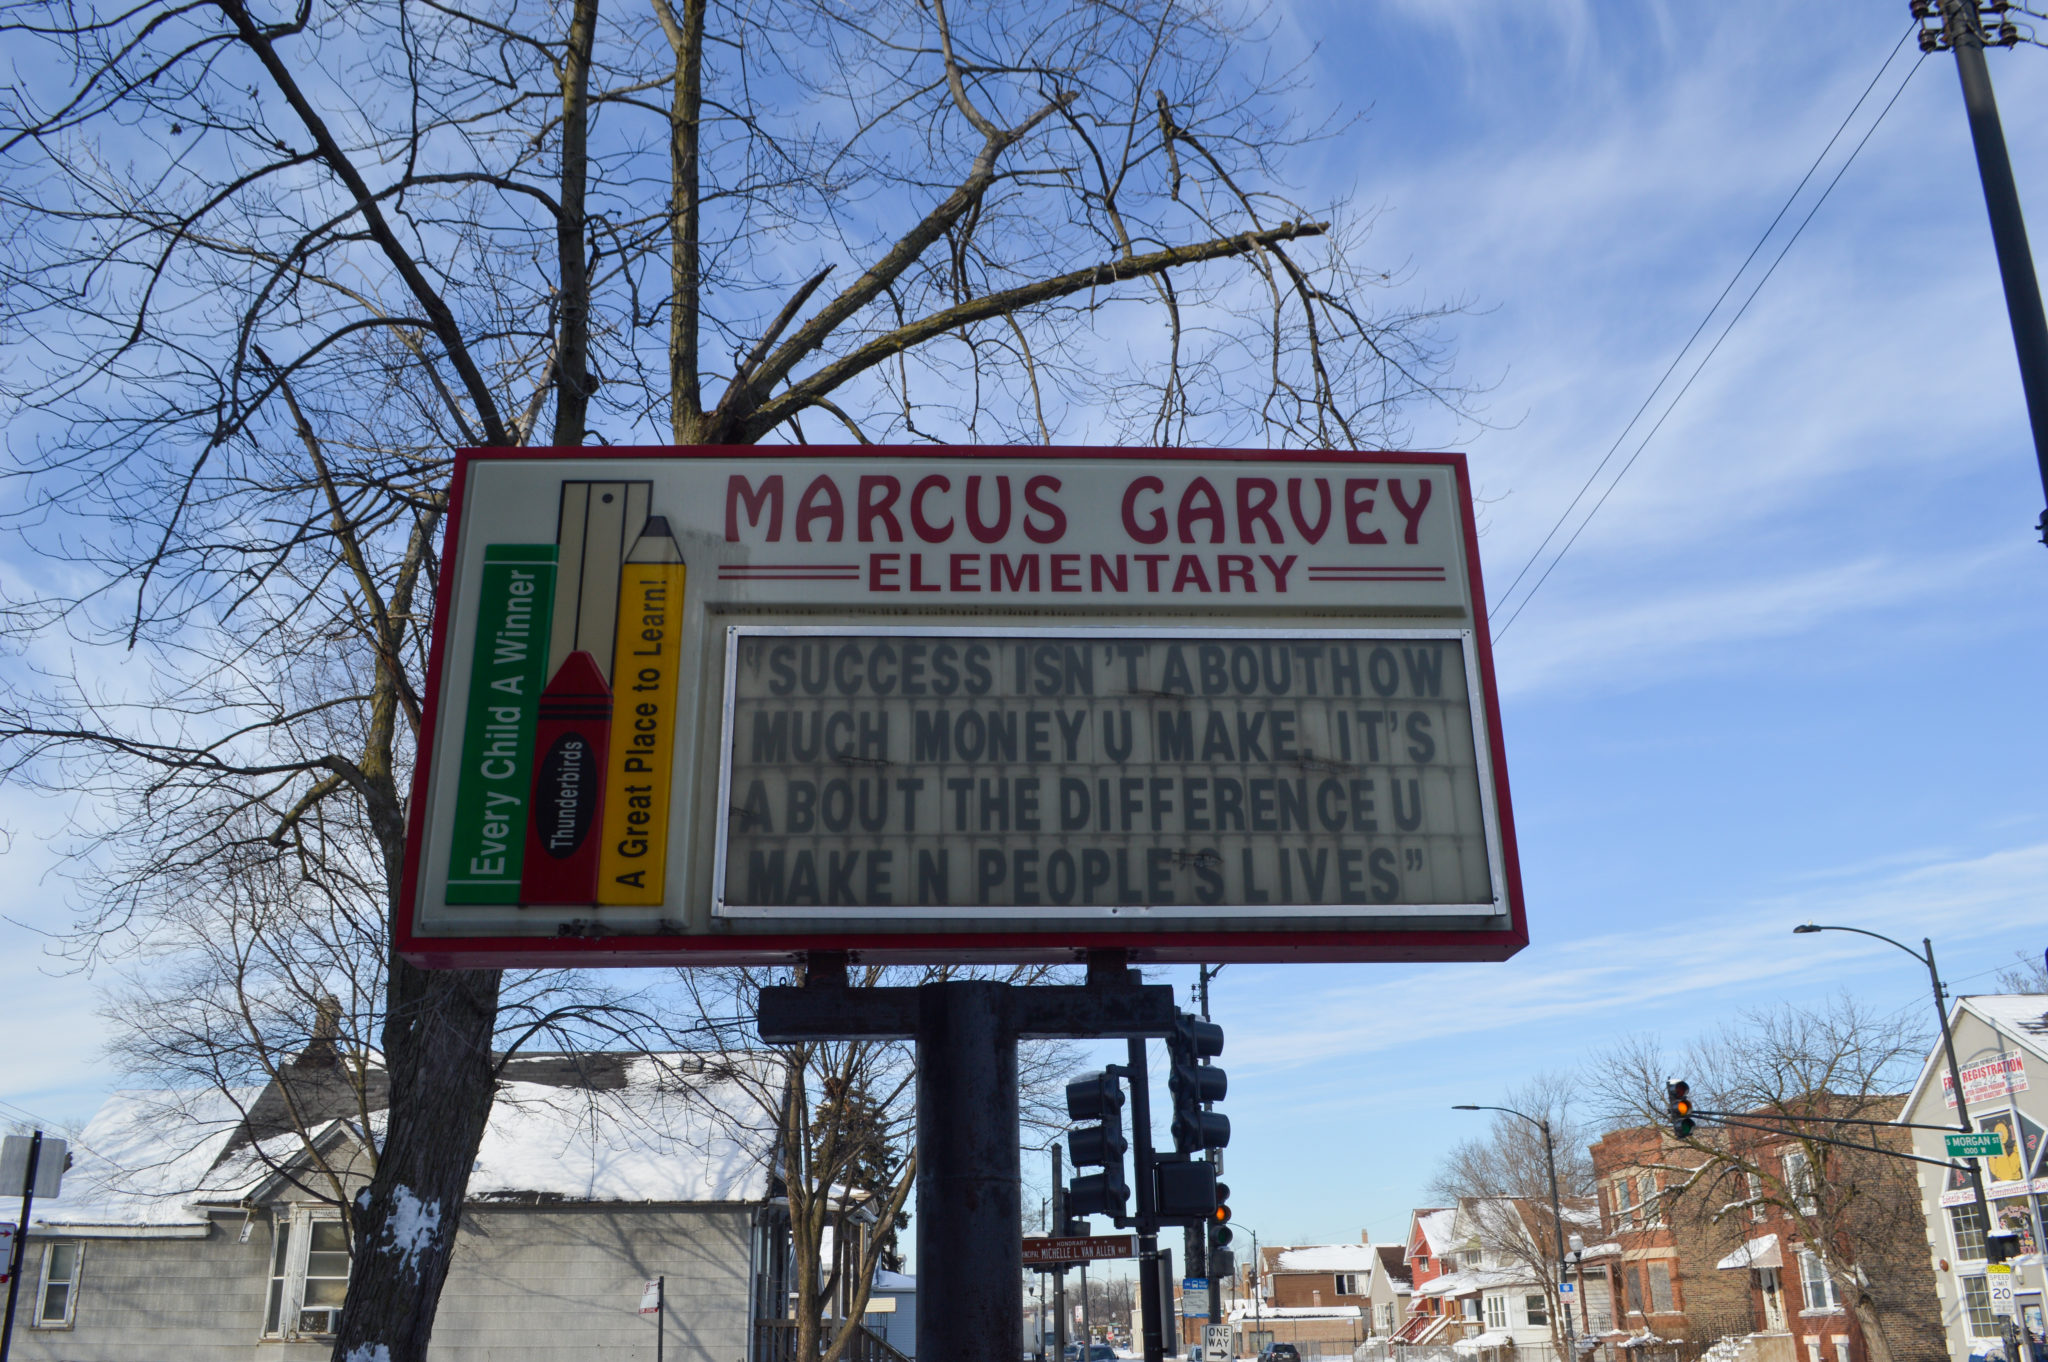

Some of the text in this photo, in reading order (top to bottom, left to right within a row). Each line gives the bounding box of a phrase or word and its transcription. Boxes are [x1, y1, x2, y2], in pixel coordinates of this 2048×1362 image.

[725, 474, 1432, 545] MARCUS GARVEY
[869, 553, 1299, 593] ELEMENTARY
[1016, 644, 1145, 696] ISN'T
[470, 569, 535, 875] Every Child A Winner
[616, 580, 667, 889] A Great Place to Learn!
[752, 710, 890, 763] MUCH
[914, 709, 1086, 762] MONEY
[1103, 710, 1133, 763] U
[1336, 710, 1436, 764] IT'S
[550, 741, 584, 849] Thunderbirds
[738, 777, 1422, 834] ABOUT THE DIFFERENCE U
[748, 849, 893, 906] MAKE
[918, 849, 950, 906] N
[976, 848, 1225, 906] PEOPLE'S
[1961, 1057, 2024, 1084] REGISTRATION
[1952, 1136, 1991, 1147] MORGAN
[1041, 1247, 1071, 1259] MICHELLE
[1081, 1246, 1095, 1257] VAN
[1096, 1245, 1116, 1257] ALLEN
[1993, 1288, 2011, 1300] 20
[1208, 1327, 1229, 1337] ONE
[1208, 1338, 1230, 1348] WAY
